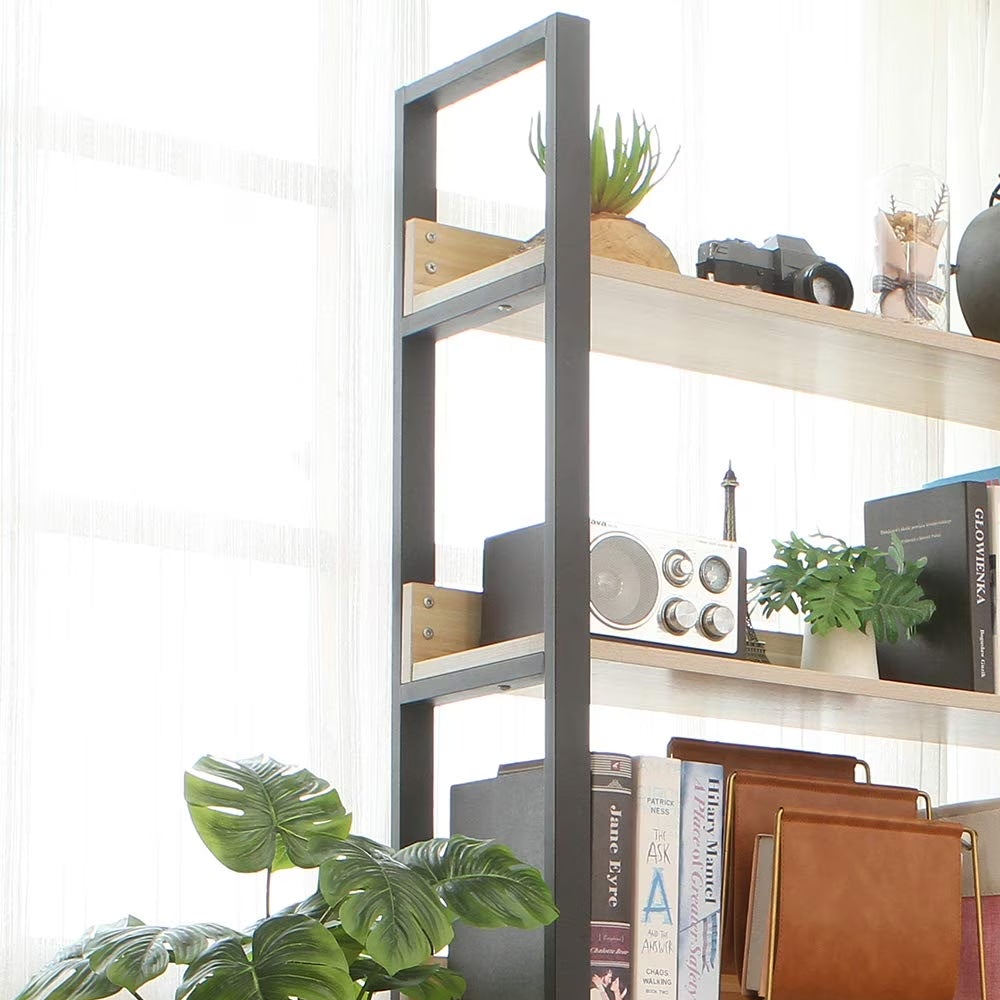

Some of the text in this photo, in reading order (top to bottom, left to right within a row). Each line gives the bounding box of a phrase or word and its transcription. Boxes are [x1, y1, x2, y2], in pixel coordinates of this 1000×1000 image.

[974, 508, 986, 605] GLOWIENKA
[646, 797, 675, 807] PATRICK
[694, 779, 706, 791] A
[650, 807, 670, 816] NESS
[692, 796, 706, 846] Place
[607, 805, 622, 908] Jane Eyre
[646, 841, 671, 865] ASK
[691, 848, 704, 869] of
[703, 778, 720, 904] Hilary Mantel
[641, 866, 674, 926] A
[689, 872, 704, 943] Greater
[642, 977, 672, 987] WALKING
[645, 968, 669, 978] CHAOS
[686, 943, 702, 1000] Safety
